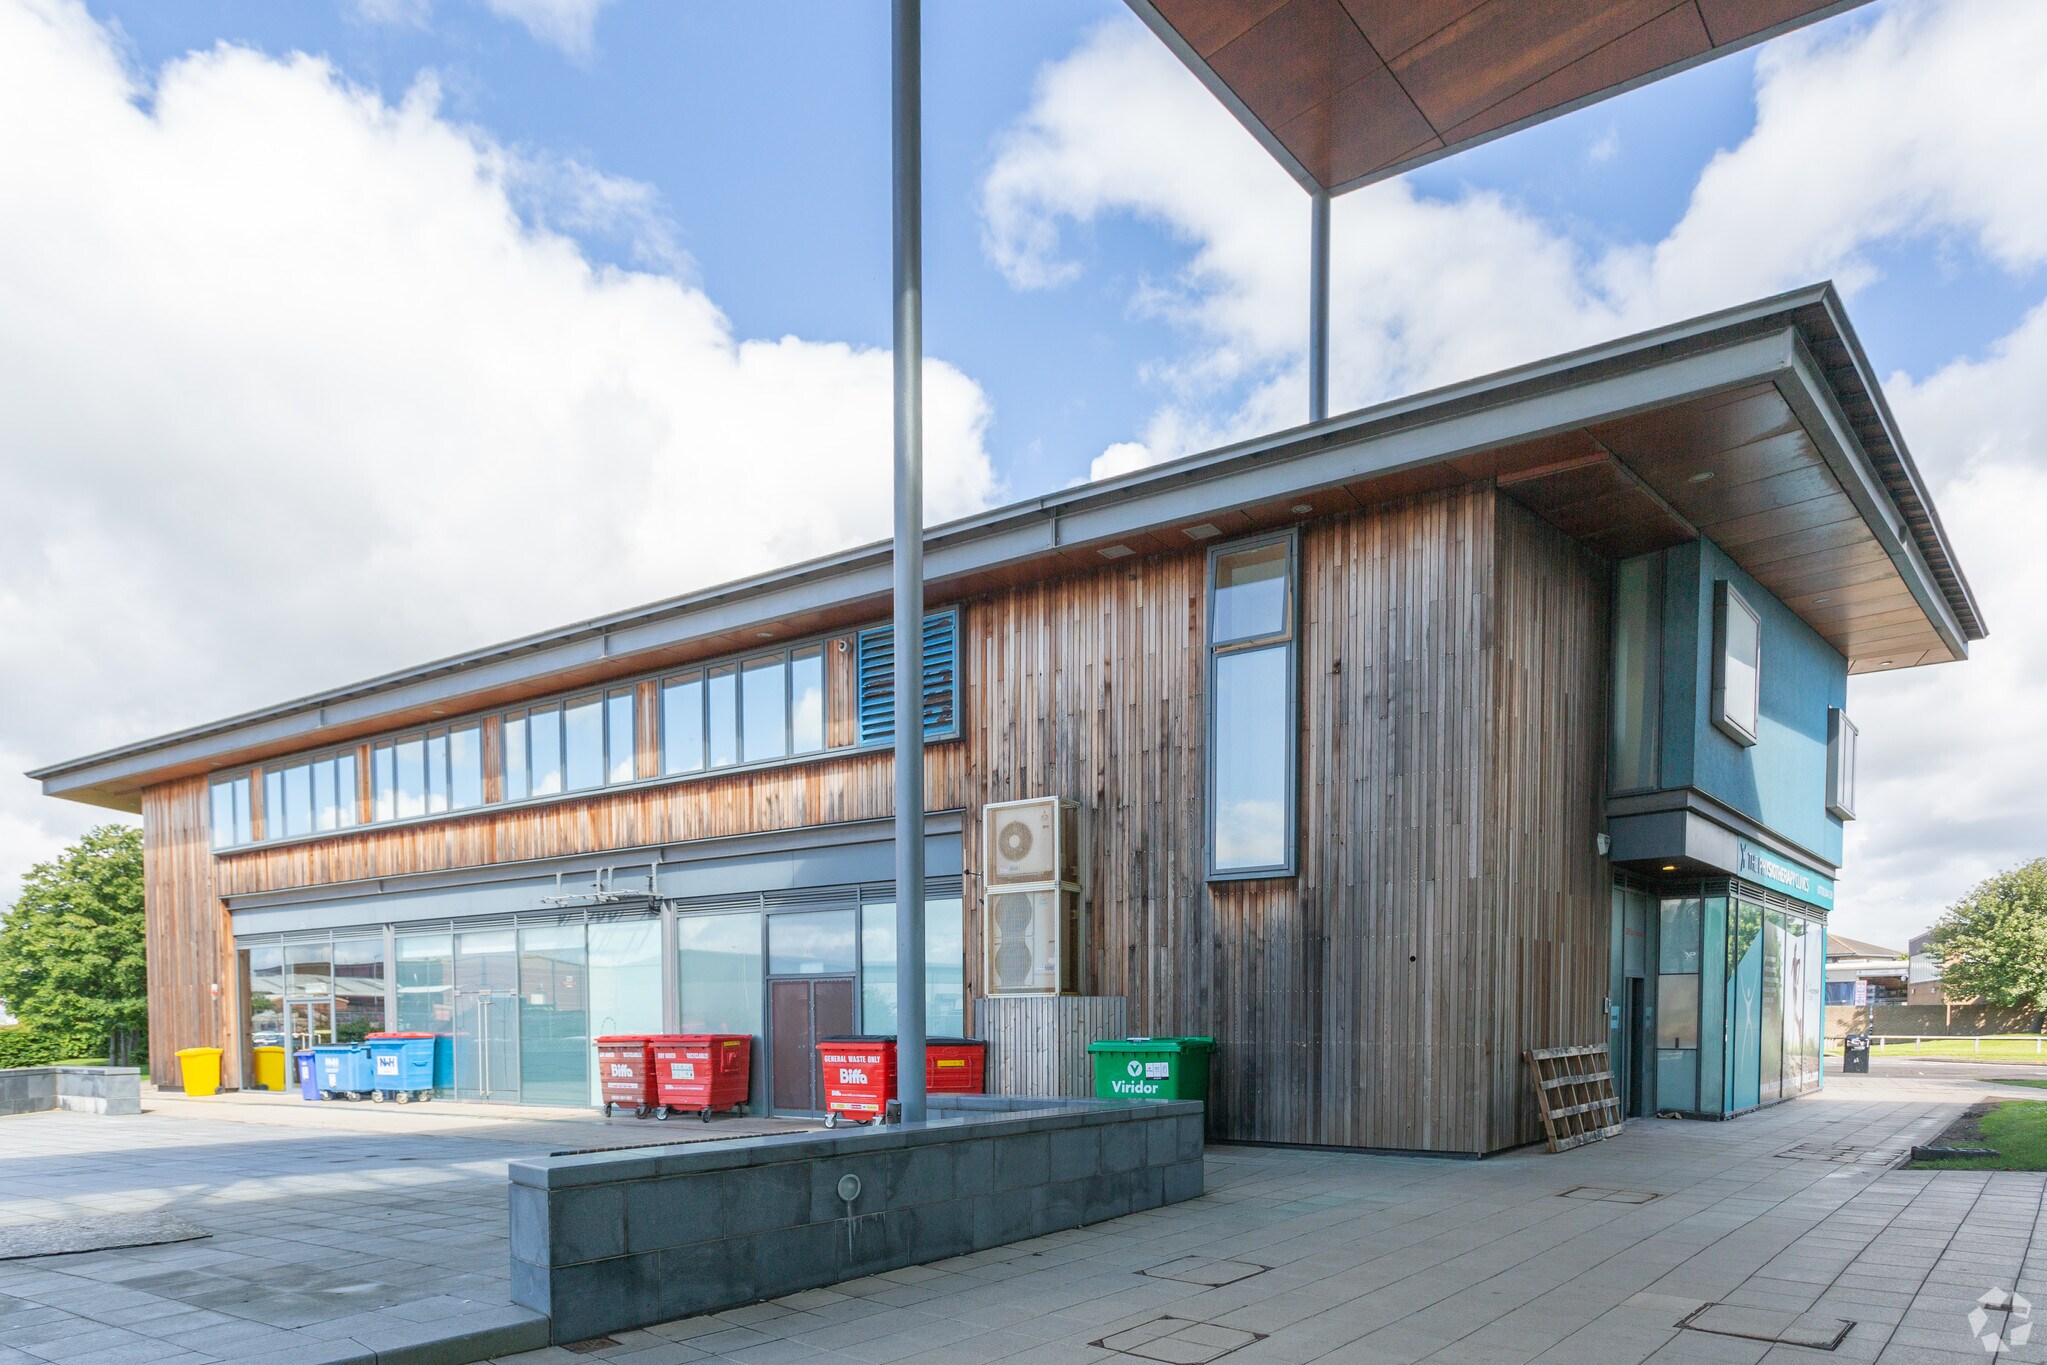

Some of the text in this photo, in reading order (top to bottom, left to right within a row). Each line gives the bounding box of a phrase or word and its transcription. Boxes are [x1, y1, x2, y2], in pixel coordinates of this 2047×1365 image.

[1747, 852, 1758, 873] THE
[824, 1055, 880, 1063] GENERAL WASTE ONLY
[611, 1063, 633, 1078] Biffa
[839, 1068, 868, 1085] Biffa
[1111, 1080, 1159, 1094] Viridor
